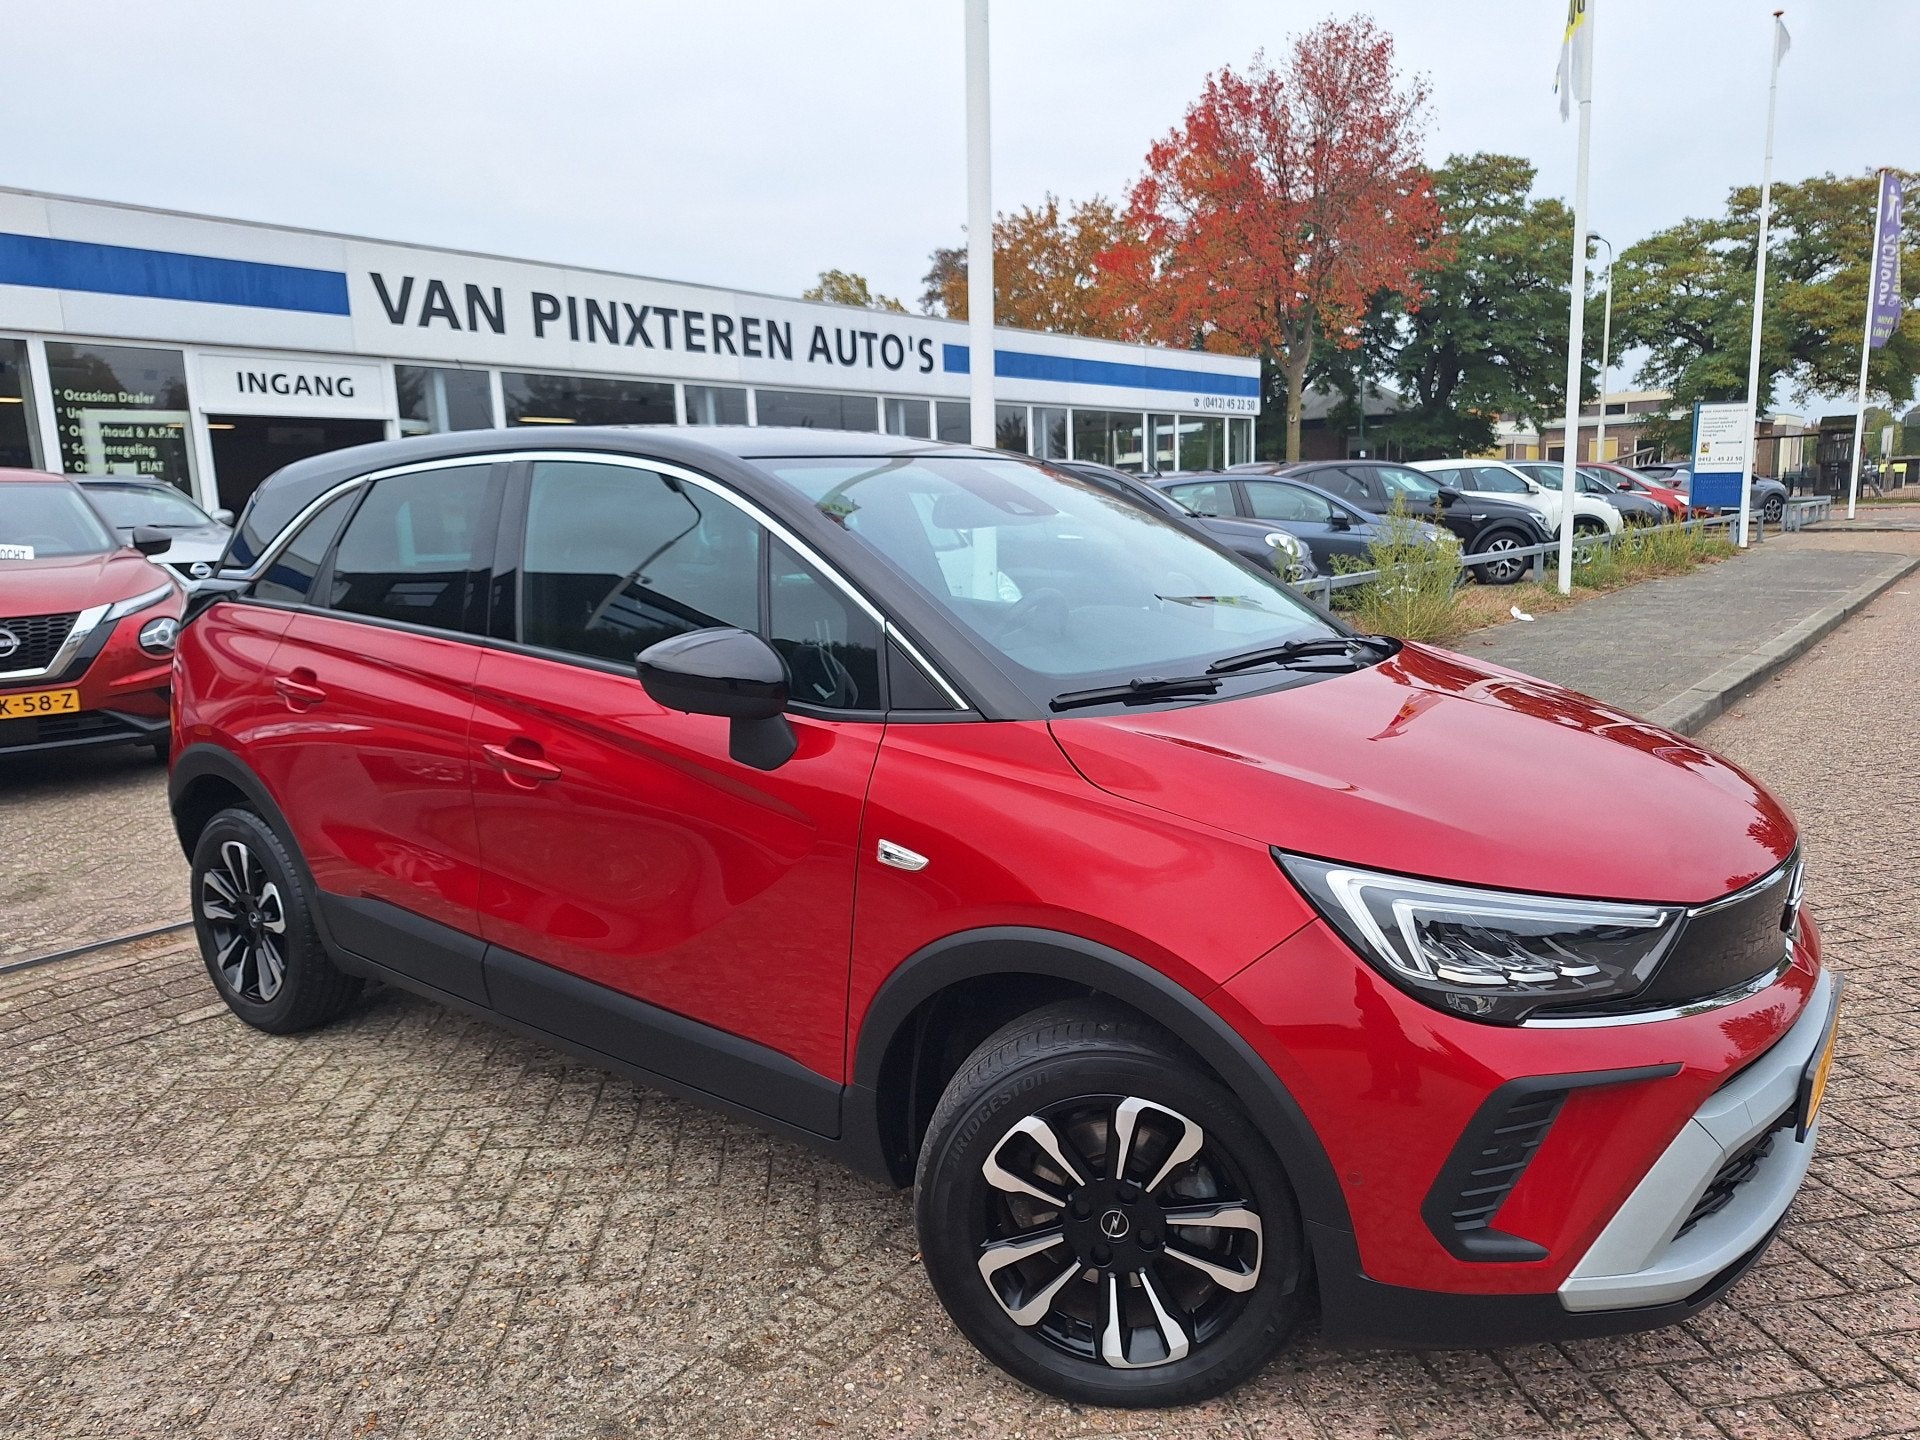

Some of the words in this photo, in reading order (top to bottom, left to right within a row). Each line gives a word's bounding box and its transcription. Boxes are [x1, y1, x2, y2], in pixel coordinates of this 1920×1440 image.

[369, 272, 505, 334] VAN
[531, 292, 792, 361] PINXTEREN
[809, 326, 933, 373] AUTO'S
[237, 371, 355, 397] INGANG
[63, 388, 116, 402] Occasion
[119, 391, 155, 404] Dealer
[1203, 396, 1225, 409] (0412)
[1227, 398, 1235, 410] 45
[1237, 399, 1245, 410] 22
[1247, 400, 1255, 411] 50
[140, 461, 164, 473] FIAT
